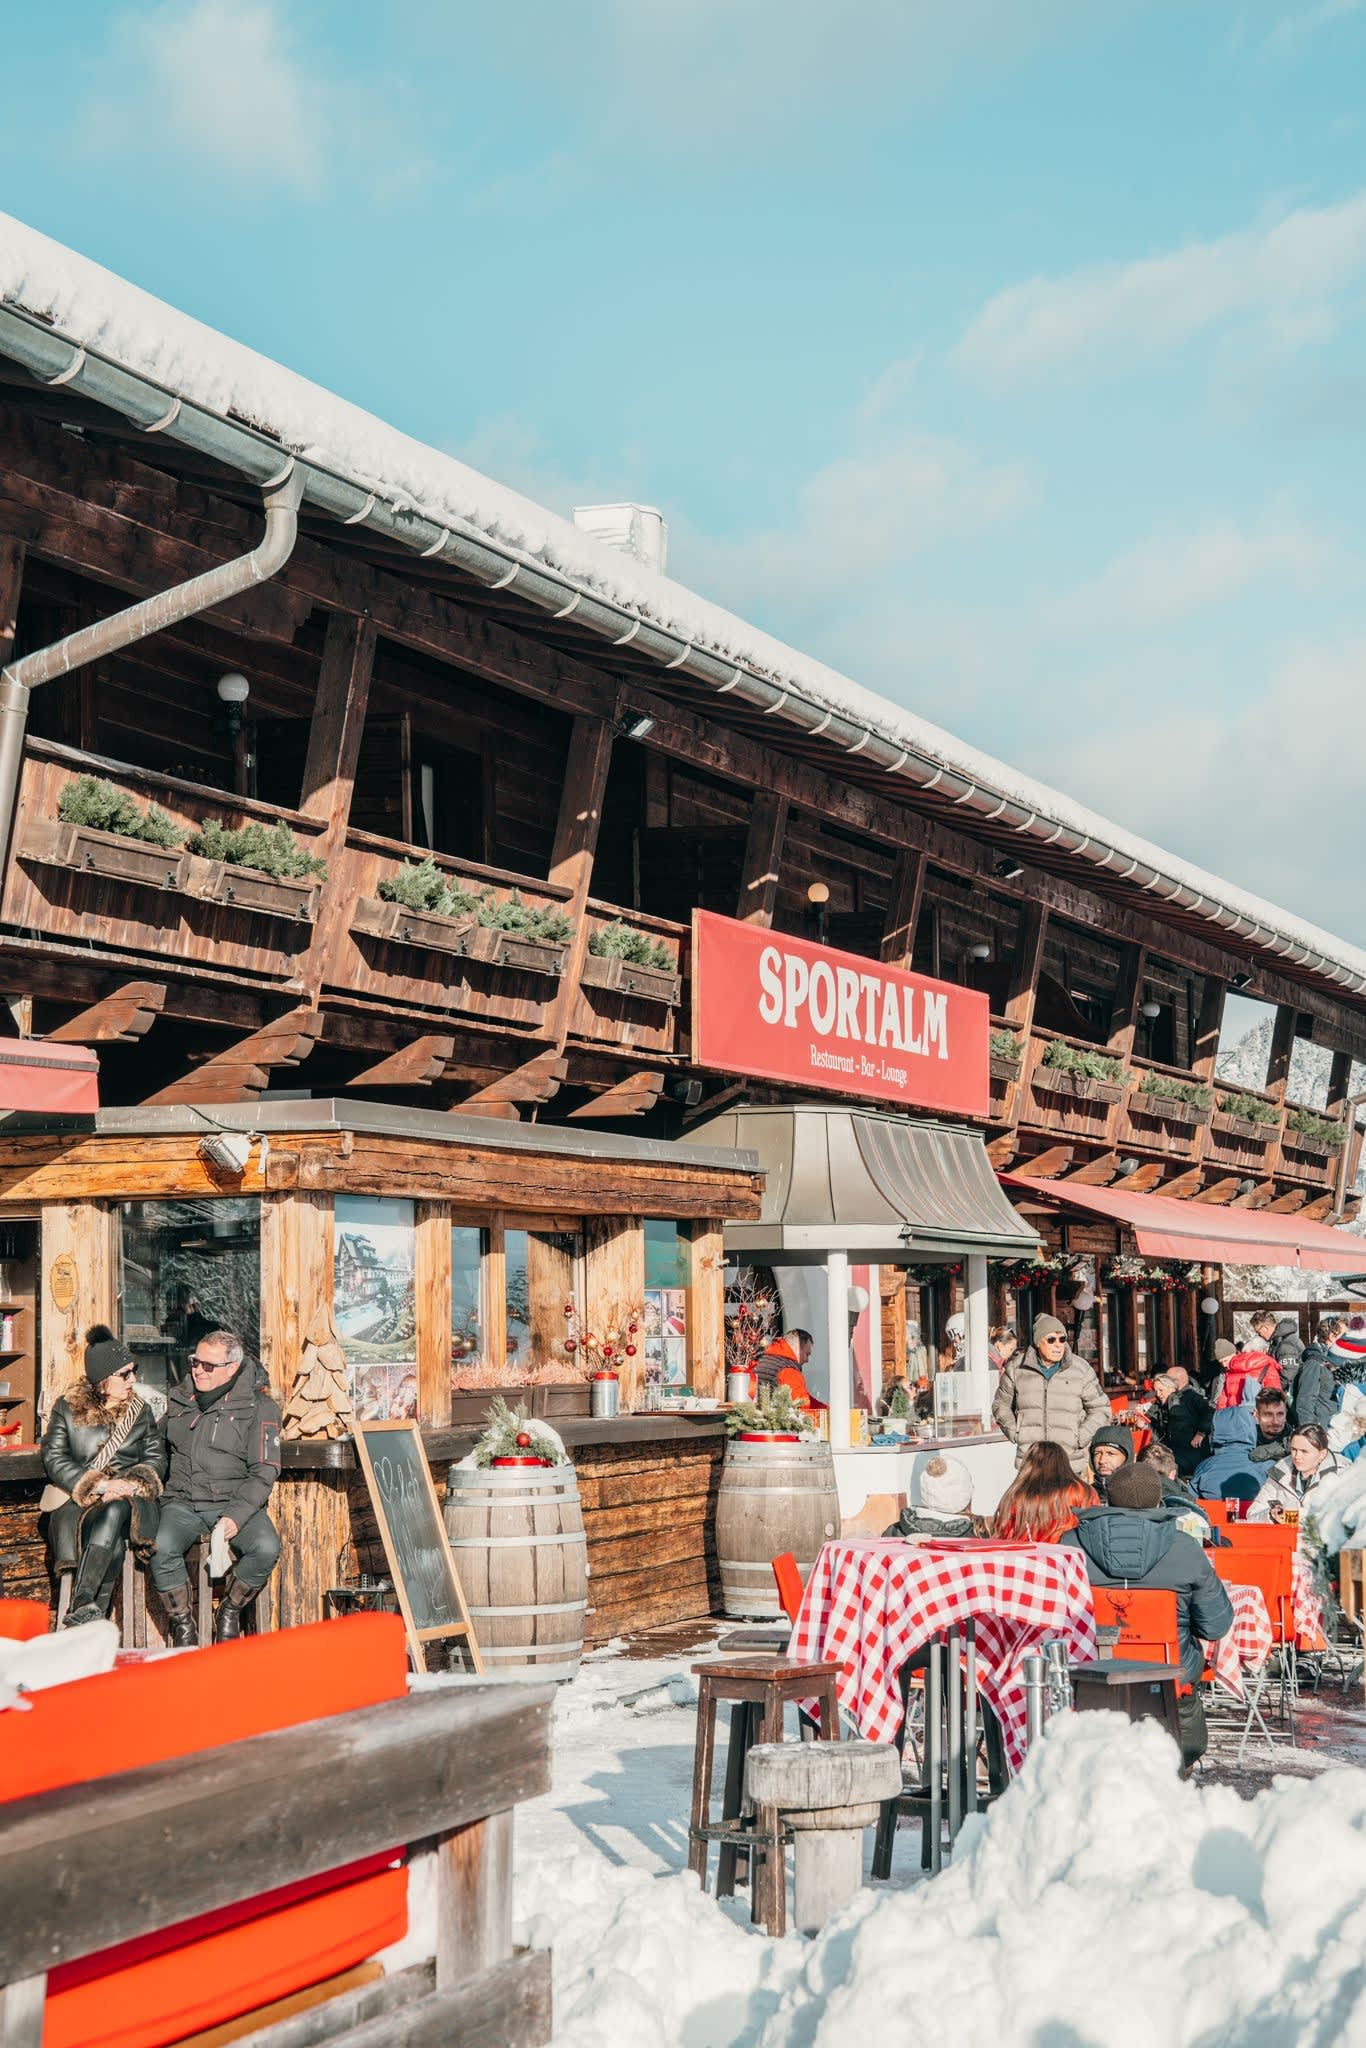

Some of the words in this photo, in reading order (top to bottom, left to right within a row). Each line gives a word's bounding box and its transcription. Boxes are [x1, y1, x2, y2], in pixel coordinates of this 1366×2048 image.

[759, 946, 948, 1059] SPORTALM
[810, 1043, 855, 1074] Restaurant
[861, 1056, 875, 1078] Bar
[881, 1060, 908, 1088] Lounge
